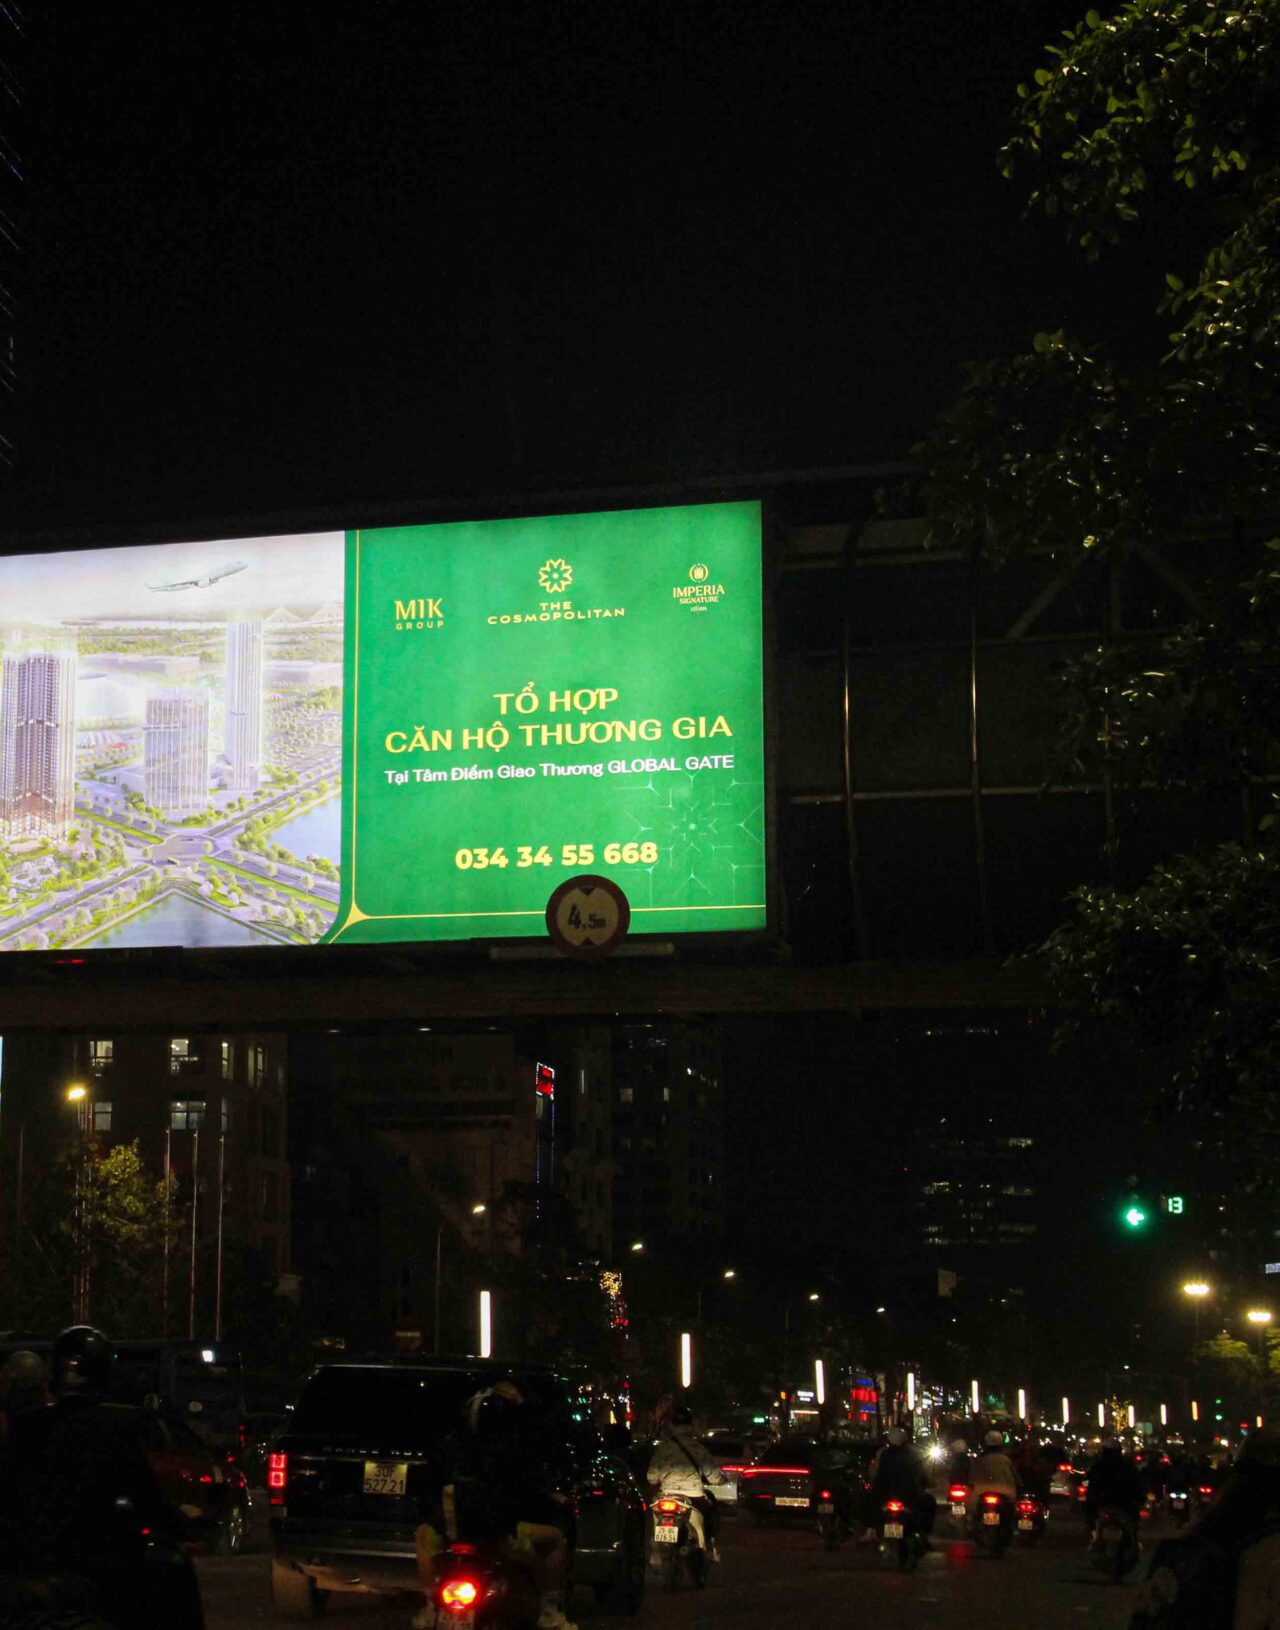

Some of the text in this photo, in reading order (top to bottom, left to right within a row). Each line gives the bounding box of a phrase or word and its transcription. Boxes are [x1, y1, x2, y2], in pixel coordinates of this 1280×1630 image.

[672, 584, 725, 598] IMPERIA
[395, 598, 443, 620] MIK
[540, 601, 572, 611] THE
[396, 620, 444, 631] GROUP
[487, 608, 625, 625] COSMOPOLITAN
[493, 681, 618, 715] TỔ HỢP
[385, 715, 733, 753] CĂN HỘ THƯƠNG GIA
[384, 770, 408, 785] Tại
[412, 768, 448, 783] Tâm
[497, 765, 536, 779] Giao
[539, 762, 604, 777] Thương
[608, 758, 681, 774] GLOBAL
[685, 755, 735, 770] GATE
[455, 842, 658, 870] 034 34 55 668
[1168, 1197, 1183, 1214] 13
